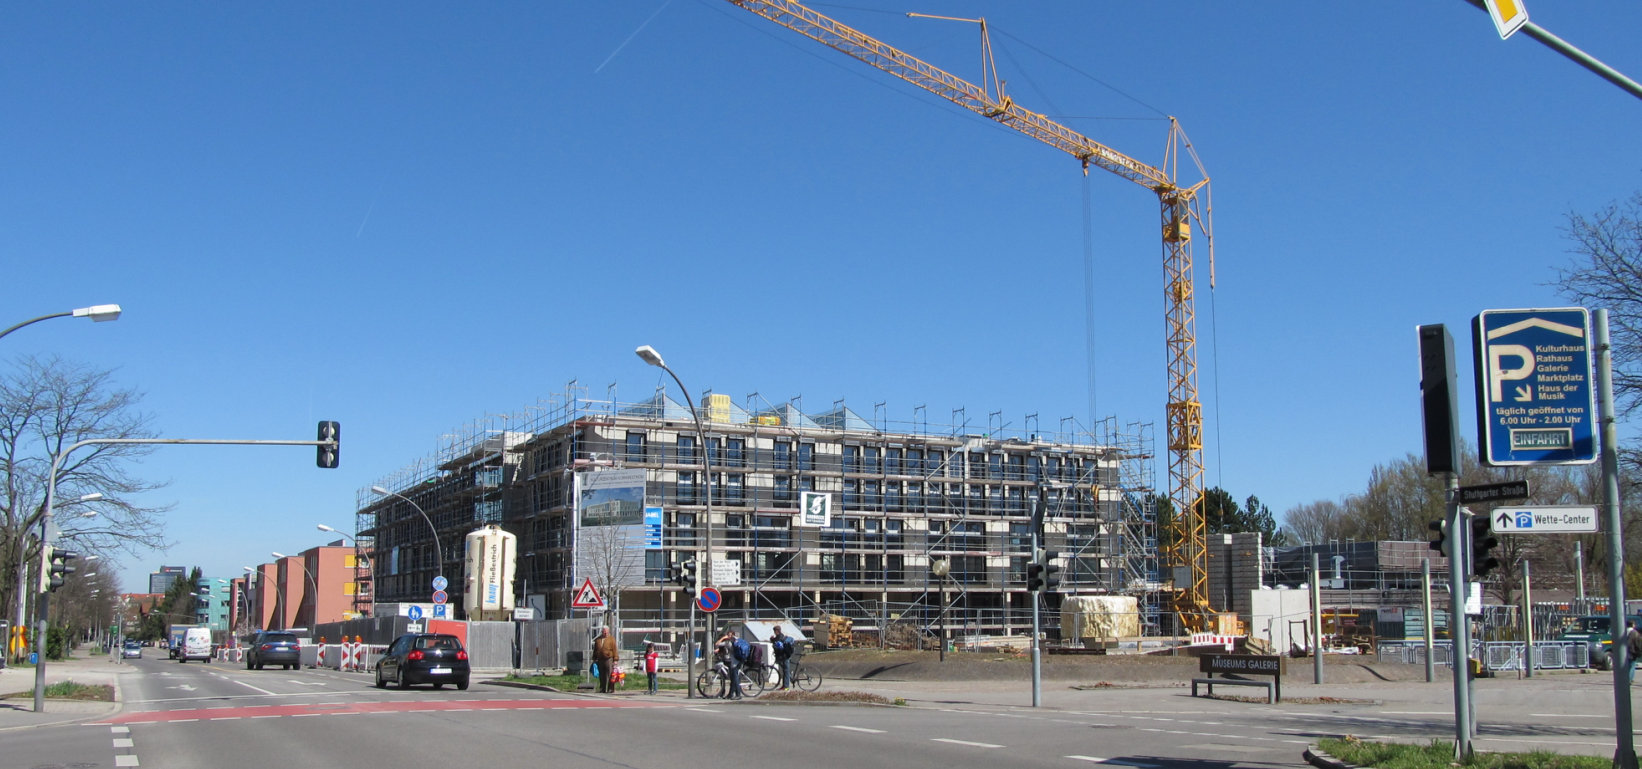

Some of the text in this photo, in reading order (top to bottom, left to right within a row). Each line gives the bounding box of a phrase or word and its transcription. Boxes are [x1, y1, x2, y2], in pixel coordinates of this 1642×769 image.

[1489, 344, 1535, 402] P
[1537, 374, 1584, 383] Marktplatz
[1538, 384, 1578, 392] Haus der
[1538, 392, 1565, 400] Musik
[1496, 407, 1525, 416] täglich
[1528, 406, 1565, 415] geöffnet
[1500, 417, 1518, 425] 6.00
[1520, 416, 1536, 424] Uhr
[1545, 416, 1562, 424] 2.00
[1513, 432, 1566, 445] EINFAHRT
[1502, 485, 1524, 496] Straße
[1534, 514, 1590, 524] Wette-Center
[489, 544, 497, 583] Fließestrich
[1212, 658, 1278, 670] MUSEUMS GALERIE
